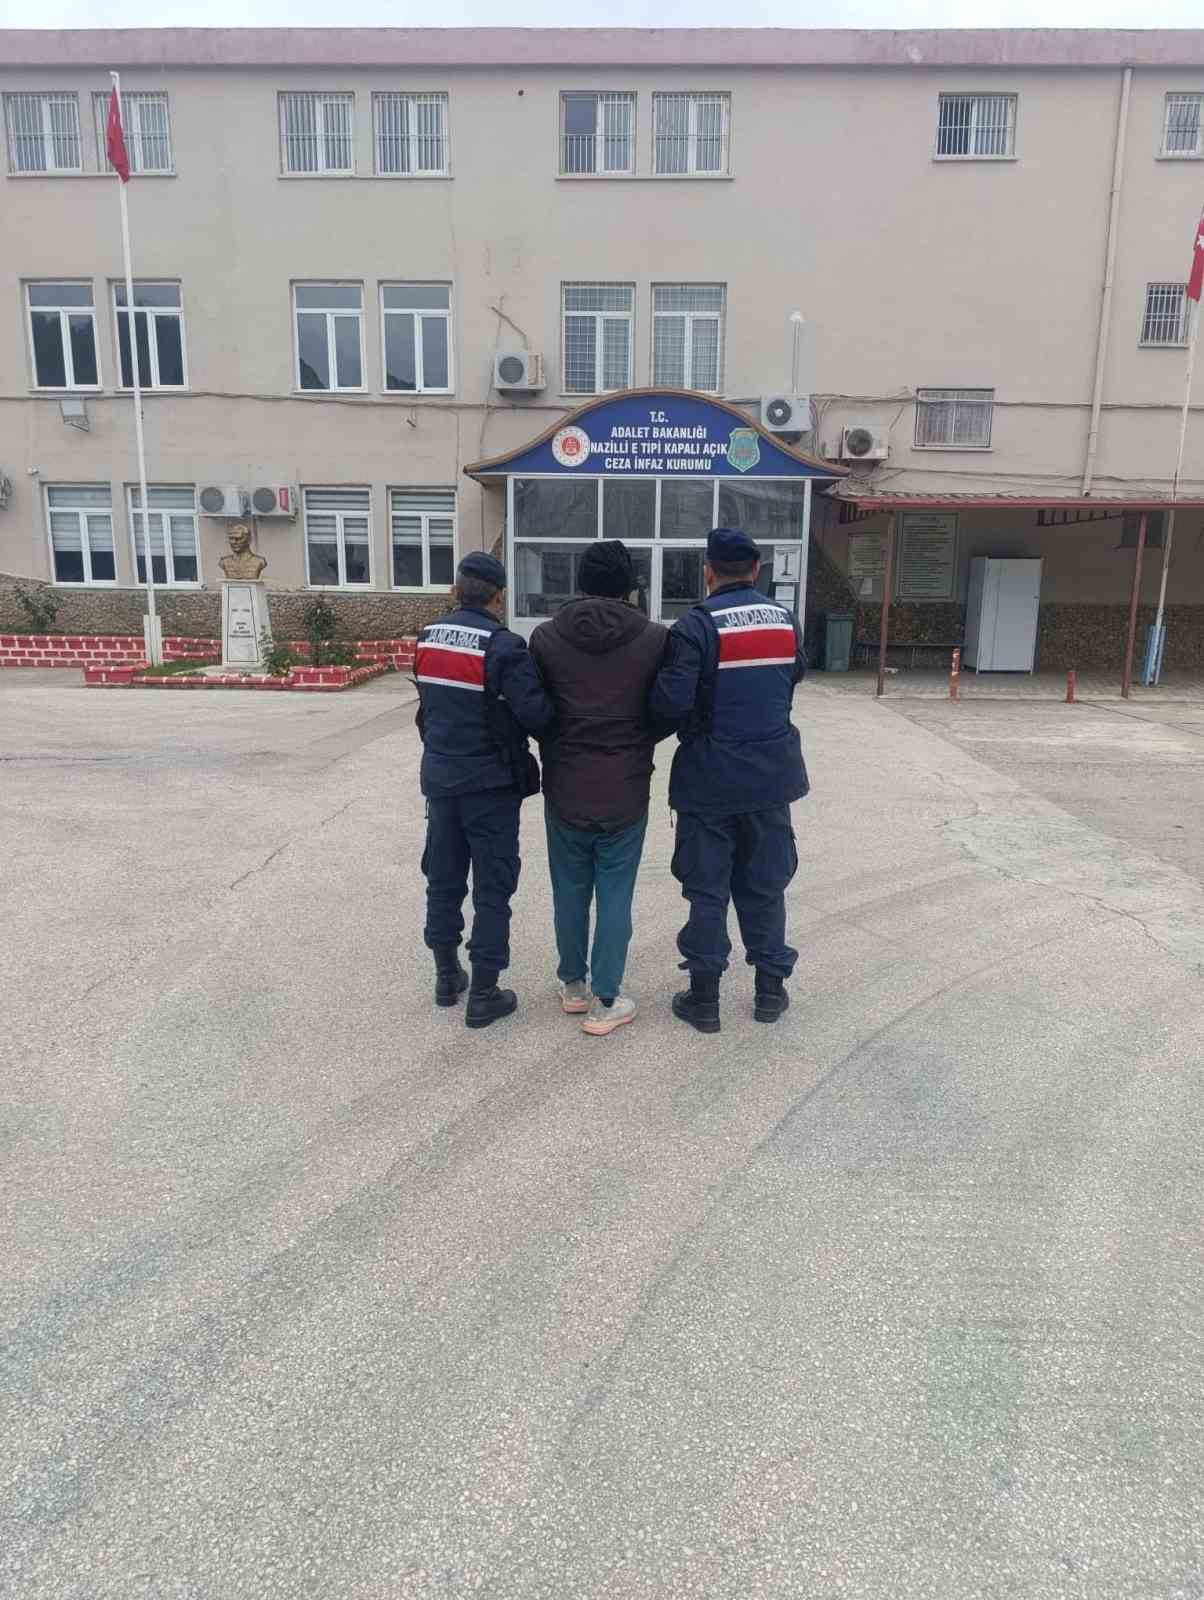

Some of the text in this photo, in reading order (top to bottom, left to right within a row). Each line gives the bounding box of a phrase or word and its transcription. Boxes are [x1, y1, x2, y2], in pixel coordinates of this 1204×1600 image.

[649, 411, 669, 423] T.C.
[611, 425, 707, 439] ADALET BAKANLIĞI
[591, 440, 728, 457] NAZİLLİ E TİPİ KAPALI AÇIK
[605, 456, 712, 470] CEZA İNFAZ KURUMU
[724, 608, 785, 627] JANDARMA
[425, 628, 480, 650] JANDARMA
